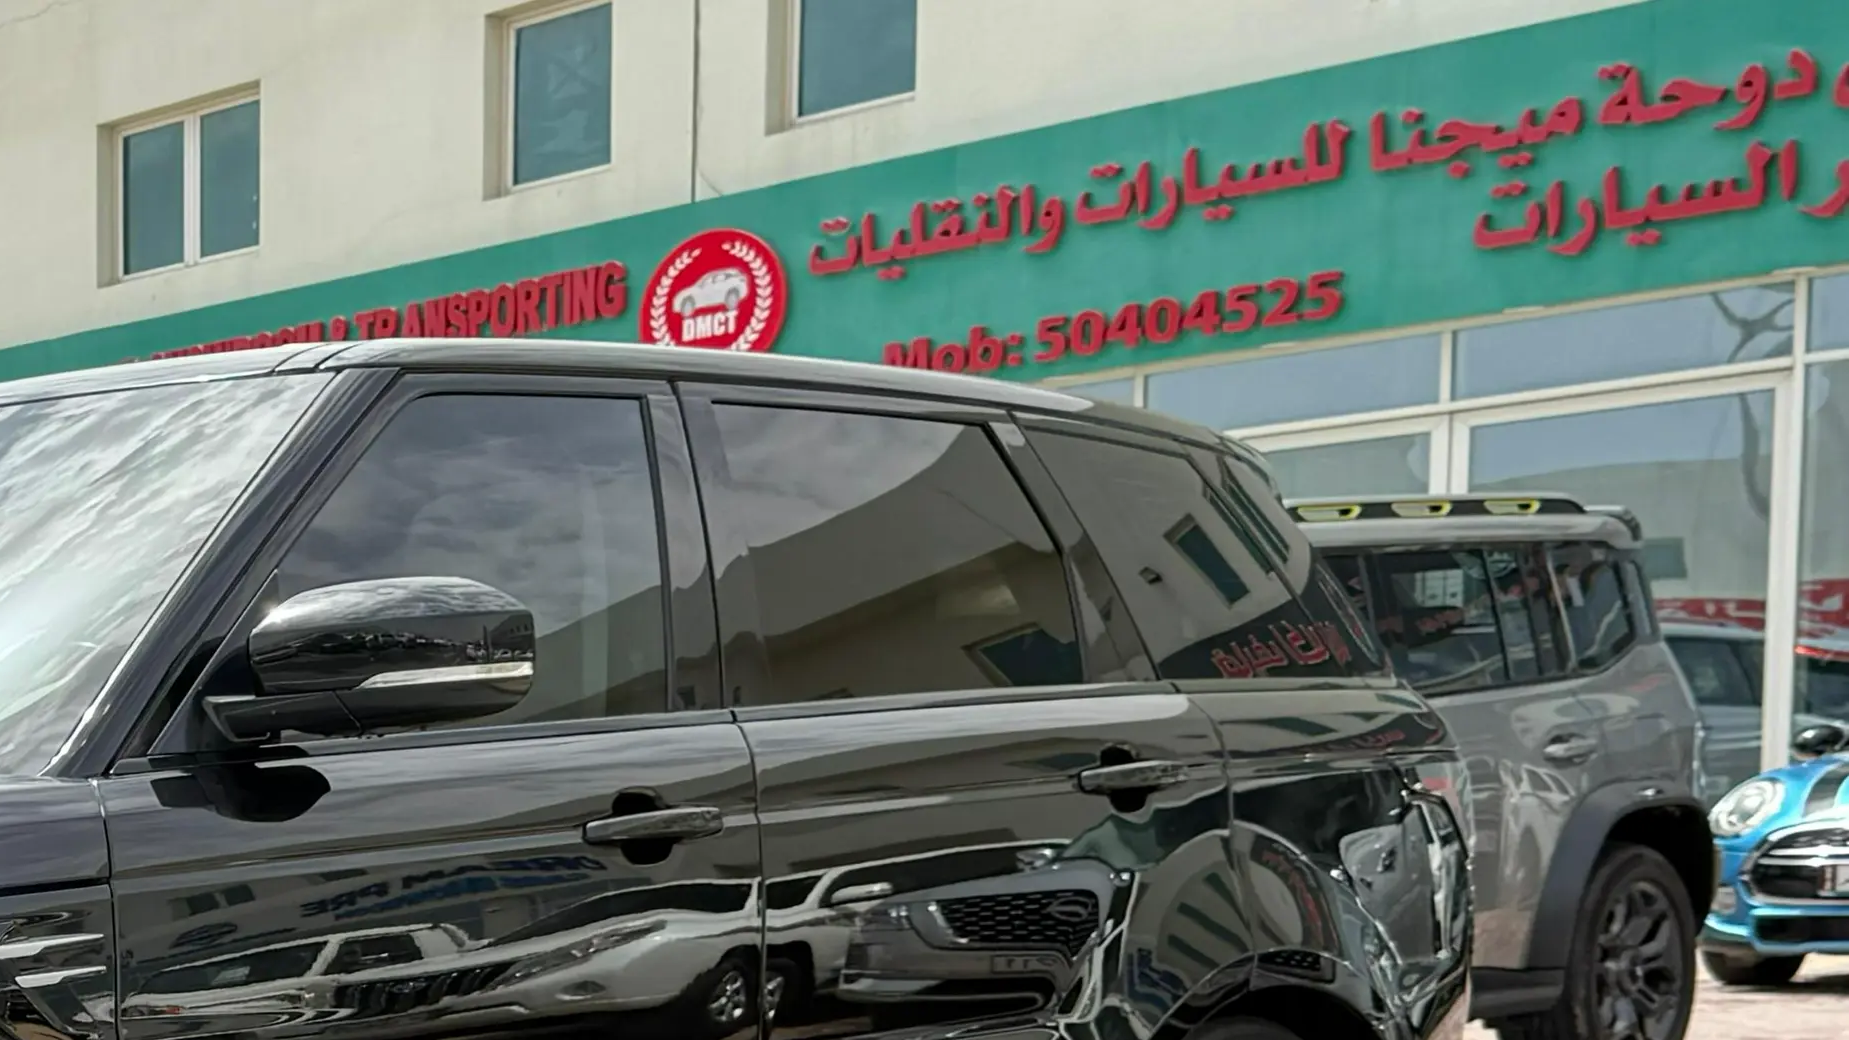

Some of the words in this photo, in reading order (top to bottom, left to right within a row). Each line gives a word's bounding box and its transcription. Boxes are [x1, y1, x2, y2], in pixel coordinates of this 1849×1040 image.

[1596, 47, 1818, 131] دوحة
[1075, 118, 1351, 230] للسيارات
[1369, 96, 1582, 179] ميجنا
[808, 184, 1066, 280] والنقليات
[1472, 138, 1798, 256] السيارات
[354, 260, 628, 341] TRANSPORTING
[681, 309, 739, 342] DMCT
[883, 324, 1023, 374] Mob:
[1034, 270, 1345, 363] 50404525
